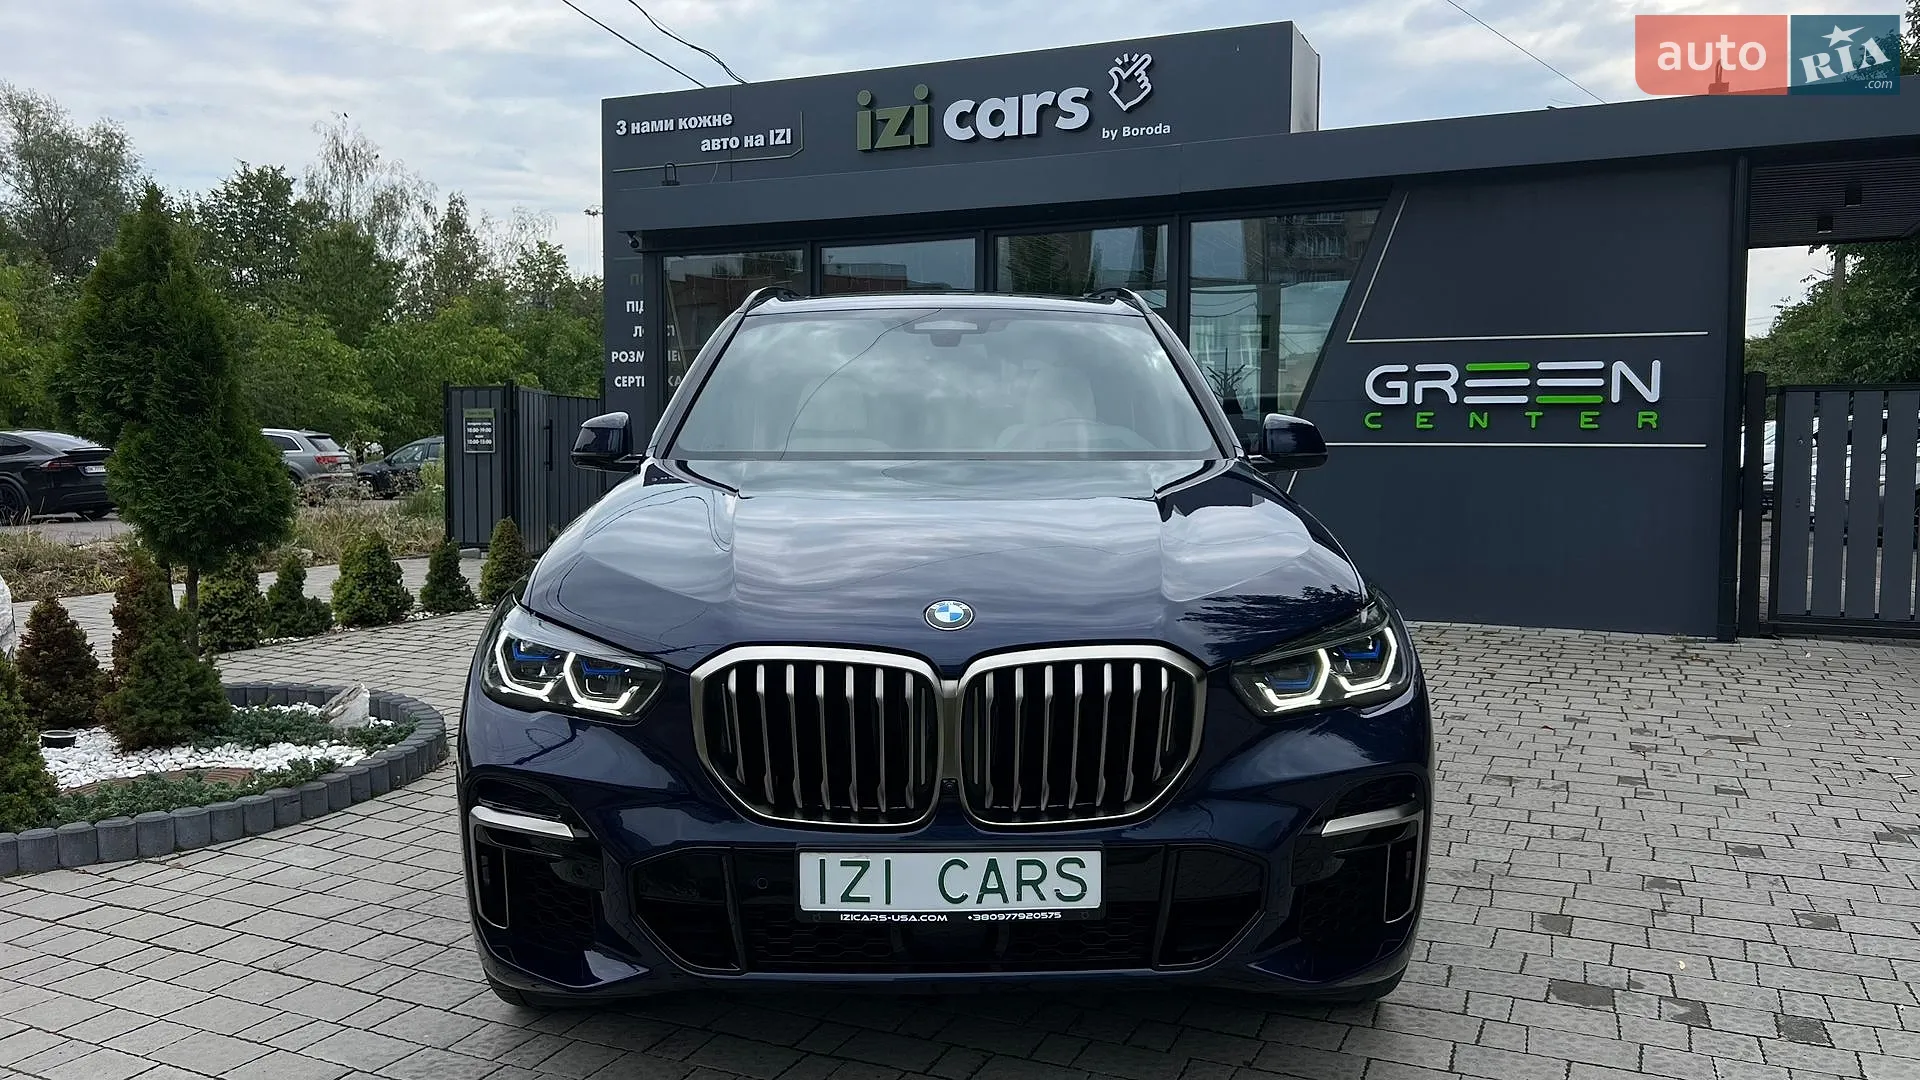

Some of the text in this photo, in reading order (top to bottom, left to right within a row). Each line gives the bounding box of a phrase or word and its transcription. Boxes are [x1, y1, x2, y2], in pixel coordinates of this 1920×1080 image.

[630, 117, 674, 135] нами
[678, 112, 733, 131] кожне
[857, 84, 1090, 151] izi cars
[700, 128, 792, 151] авто на IZI
[1102, 123, 1171, 139] by Boroda
[1365, 359, 1661, 405] GREEN
[1364, 411, 1659, 429] CENTER
[819, 857, 1087, 905] IZI CARS
[840, 911, 1061, 922] IZICARS-USA.COM +380977920575
